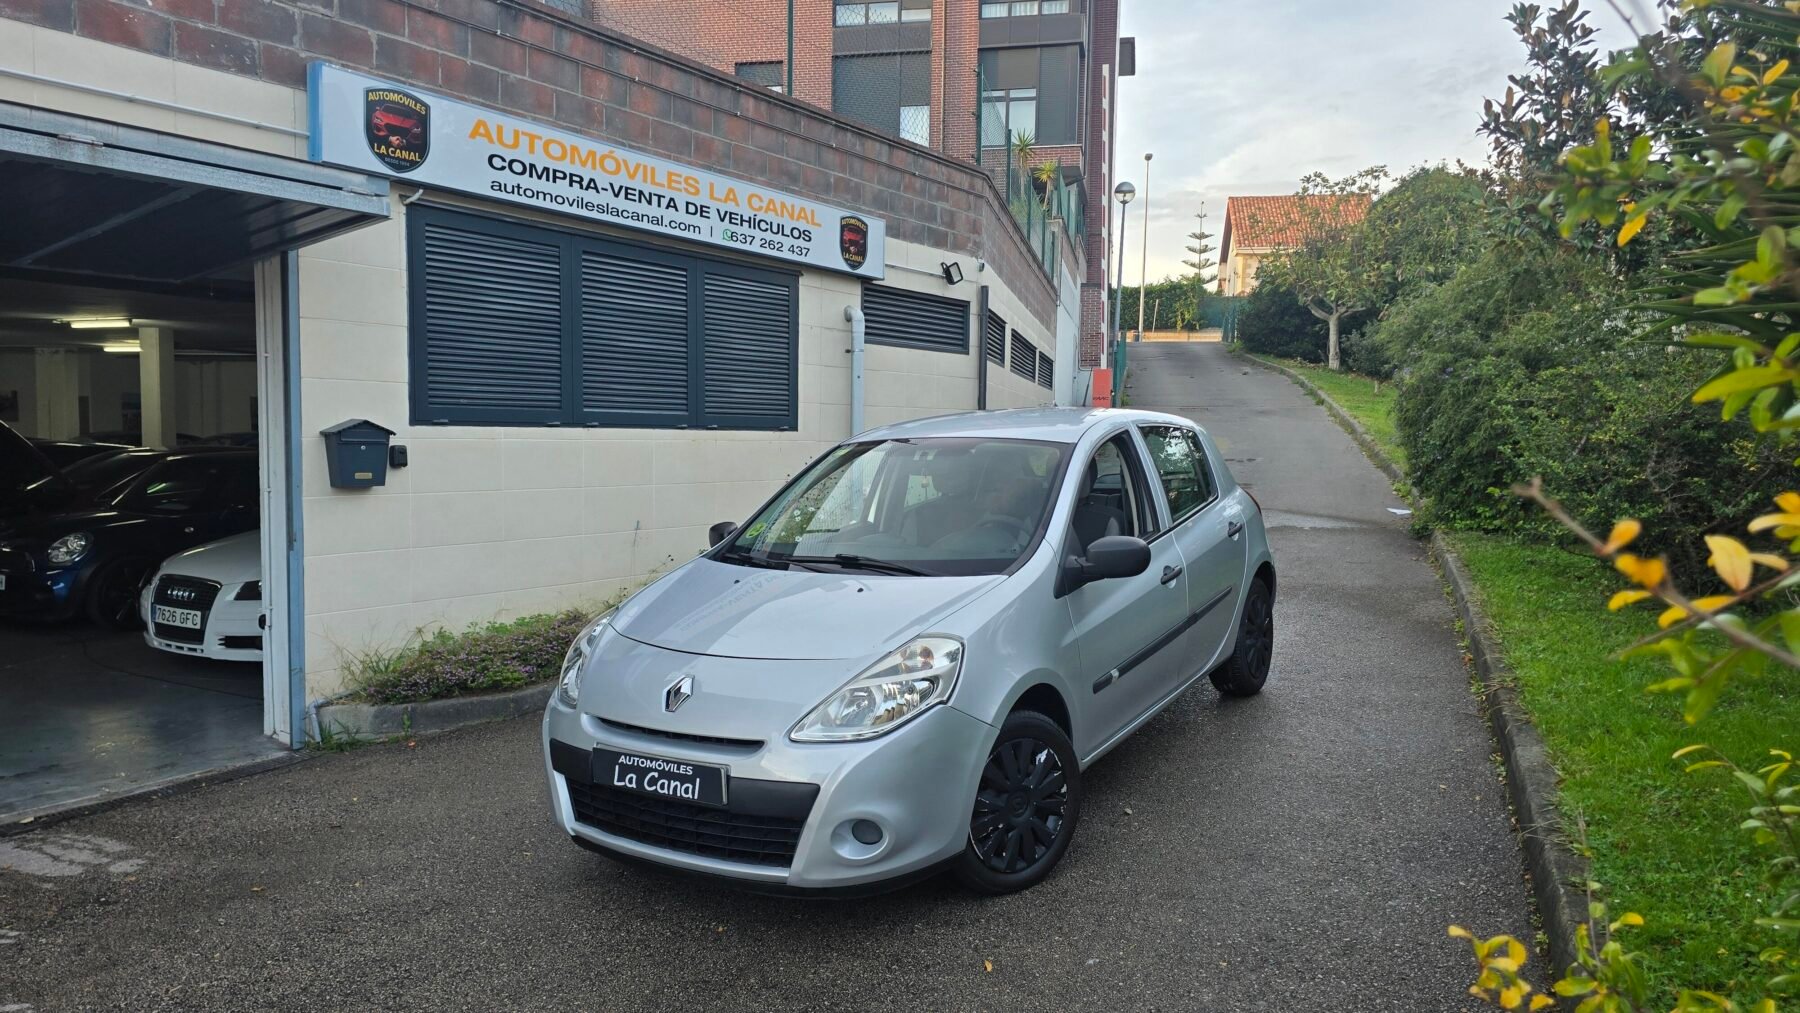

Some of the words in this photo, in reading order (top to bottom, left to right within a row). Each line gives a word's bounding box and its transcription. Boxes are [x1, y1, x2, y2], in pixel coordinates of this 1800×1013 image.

[368, 91, 426, 115] AUTOMÓVILES
[374, 143, 387, 155] LA
[388, 147, 421, 162] CANAL
[468, 118, 700, 196] AUTOMÓVILES
[709, 182, 740, 206] LA
[747, 193, 822, 227] CANAL
[487, 153, 679, 212] COMPRA-VENTA
[685, 201, 711, 219] DE
[716, 208, 813, 242] VEHÍCULOS
[490, 179, 702, 235] automovileslacanal.com
[730, 231, 755, 246] 637
[759, 237, 784, 252] 262
[787, 243, 811, 257] 437
[157, 607, 177, 623] 7626
[179, 612, 198, 626] GFC
[618, 755, 693, 775] AUTOMÓVILES
[613, 765, 637, 788] La
[643, 771, 700, 800] Canal
